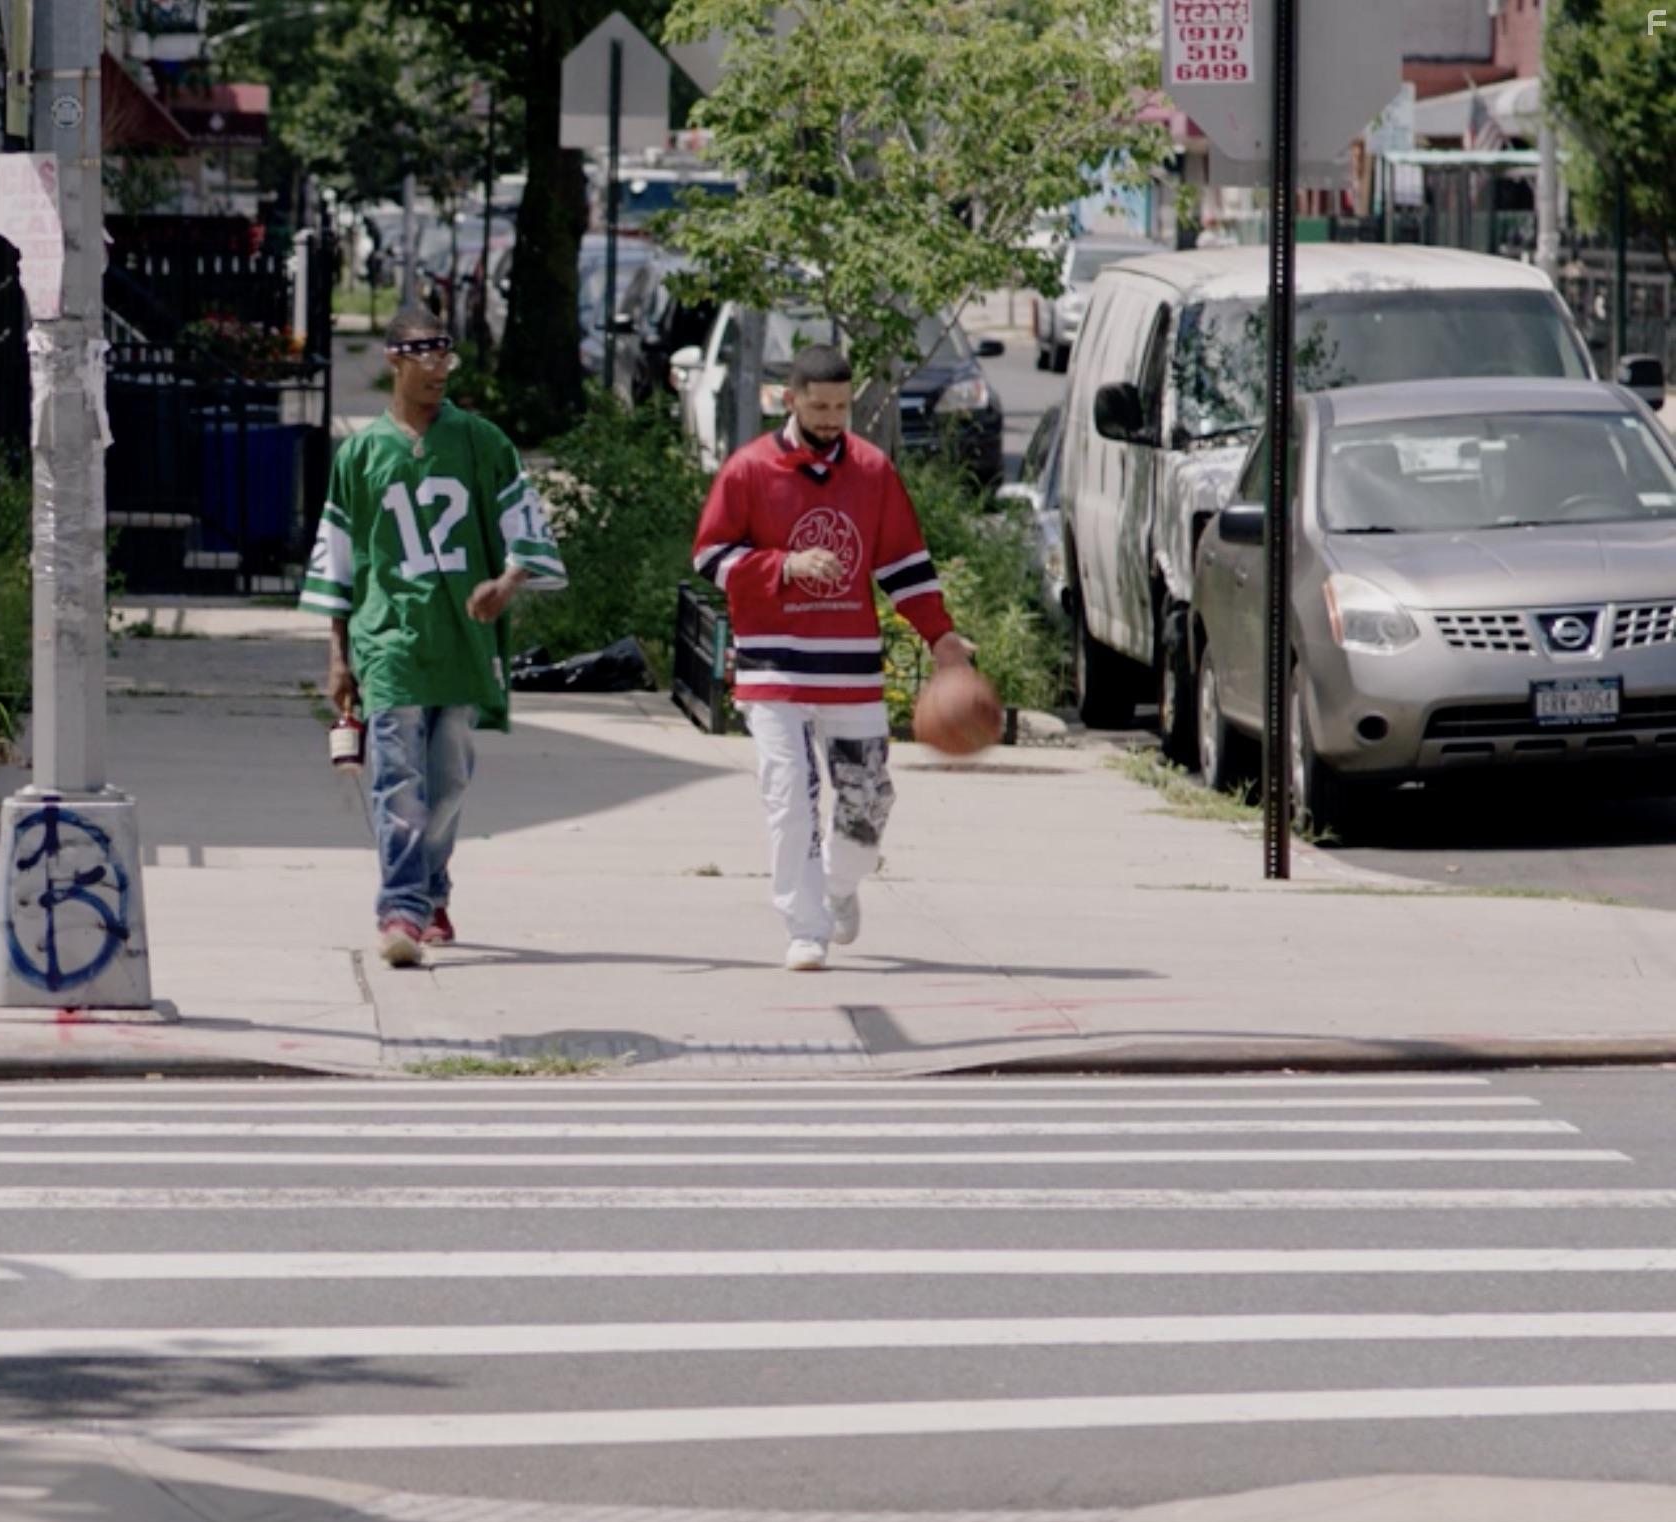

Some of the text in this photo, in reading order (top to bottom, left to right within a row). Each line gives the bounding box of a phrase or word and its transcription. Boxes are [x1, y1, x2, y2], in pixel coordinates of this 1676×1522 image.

[1179, 25, 1244, 42] (917)
[1187, 43, 1238, 61] 515
[1175, 63, 1248, 81] 6499
[381, 475, 471, 581] 12
